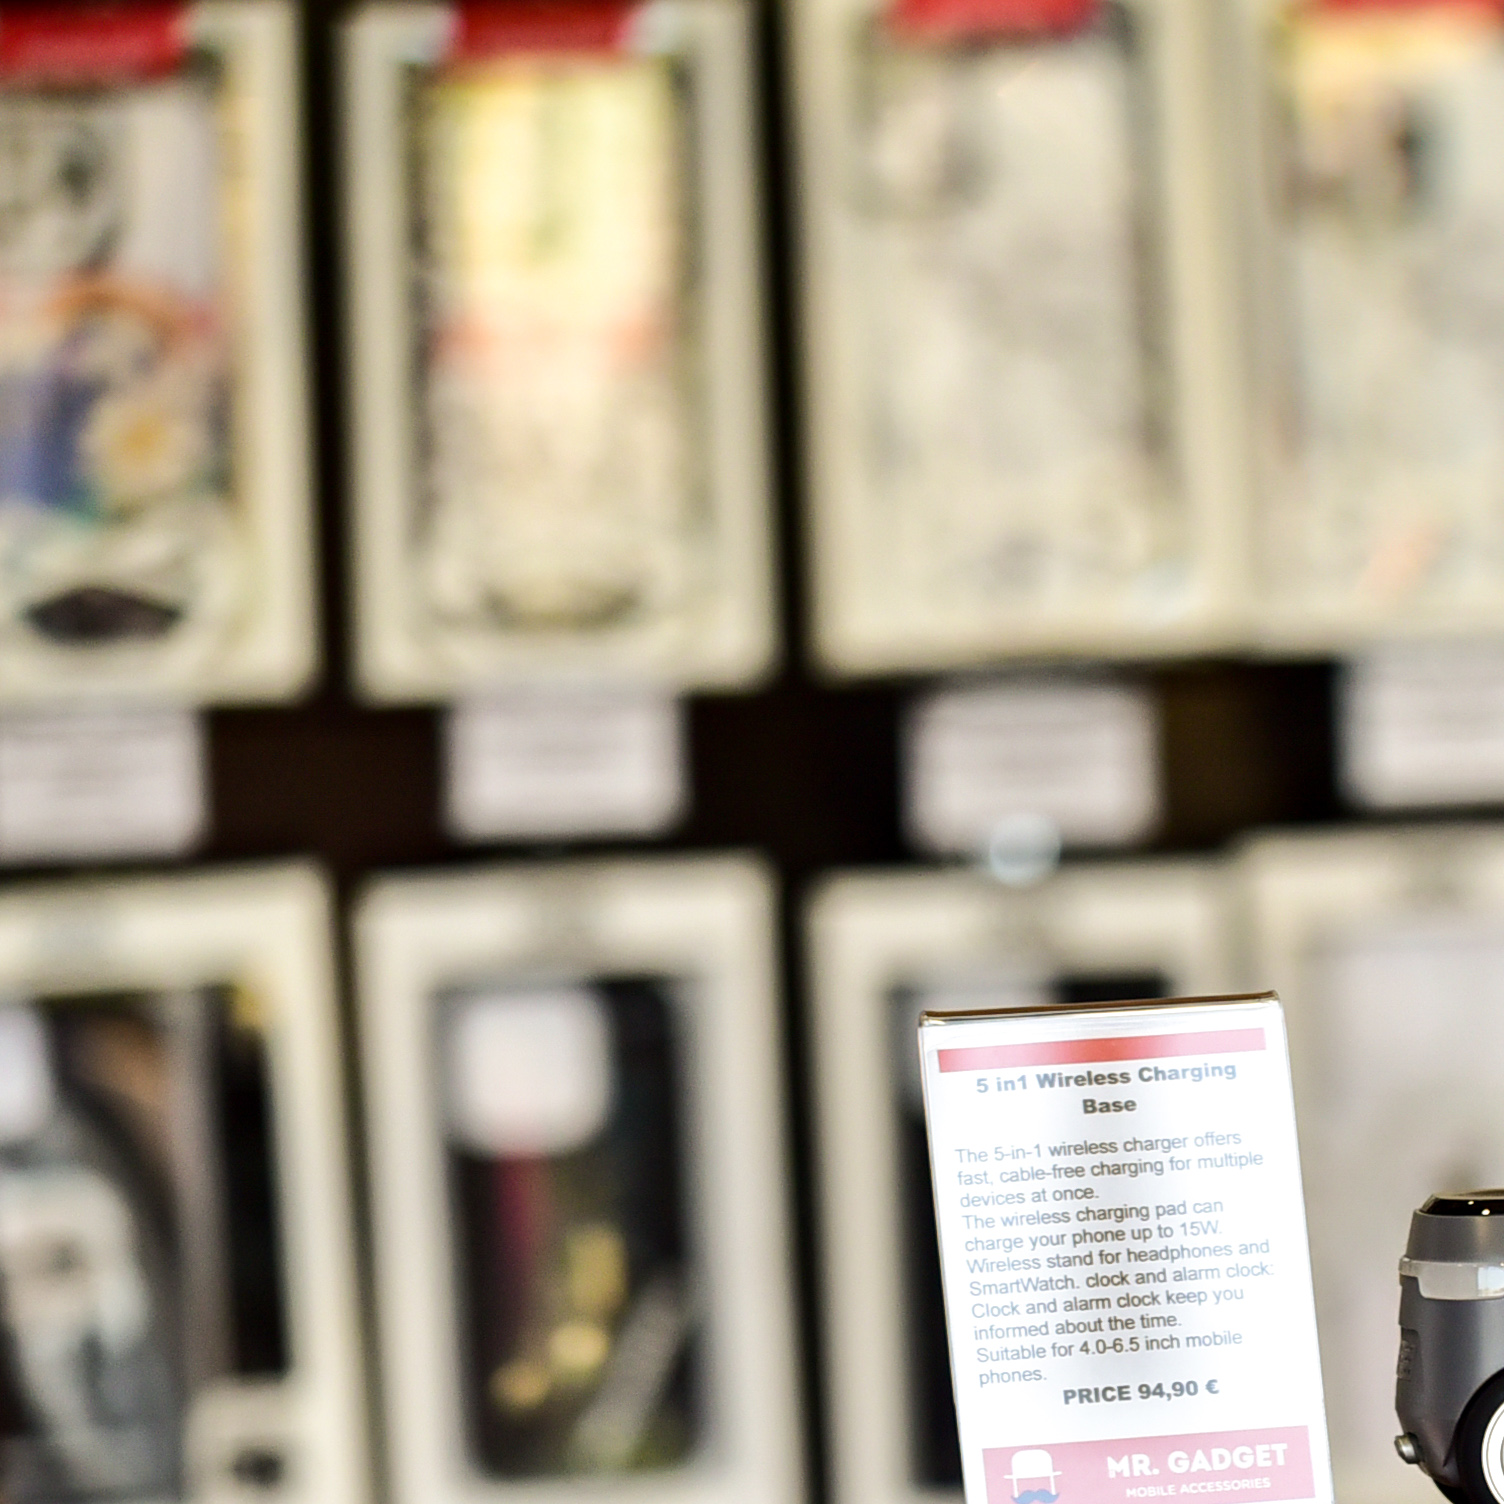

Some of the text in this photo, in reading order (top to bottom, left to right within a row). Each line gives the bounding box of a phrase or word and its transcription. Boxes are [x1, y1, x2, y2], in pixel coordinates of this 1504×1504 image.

[976, 1063, 1237, 1093] 5 in1 Wireless Charging
[1082, 1098, 1137, 1114] Base
[956, 1131, 1242, 1163] The 5-in-1 wireless charger offers
[957, 1152, 1264, 1186] fast, cable-free charging for multiple
[960, 1187, 1100, 1208] devices at once.
[962, 1200, 1224, 1229] The wireless charging pad can
[965, 1220, 1223, 1253] charge your phone up to 15W.
[966, 1239, 1270, 1274] Wireless stand for headphones and
[1085, 1270, 1130, 1288] clock
[1135, 1267, 1167, 1285] and
[1173, 1266, 1220, 1282] alarm
[971, 1288, 1244, 1319] Clock and alarm clock keep you
[974, 1313, 1182, 1341] informed about the time.
[976, 1330, 1243, 1363] Suitable for 4.0-6.5 inch mobile
[979, 1368, 1047, 1388] phones.
[1063, 1379, 1219, 1405] PRICE 94,90 €
[1107, 1443, 1288, 1478] MR. GADGET
[1126, 1477, 1271, 1498] MOBILE ACCESSORIES
